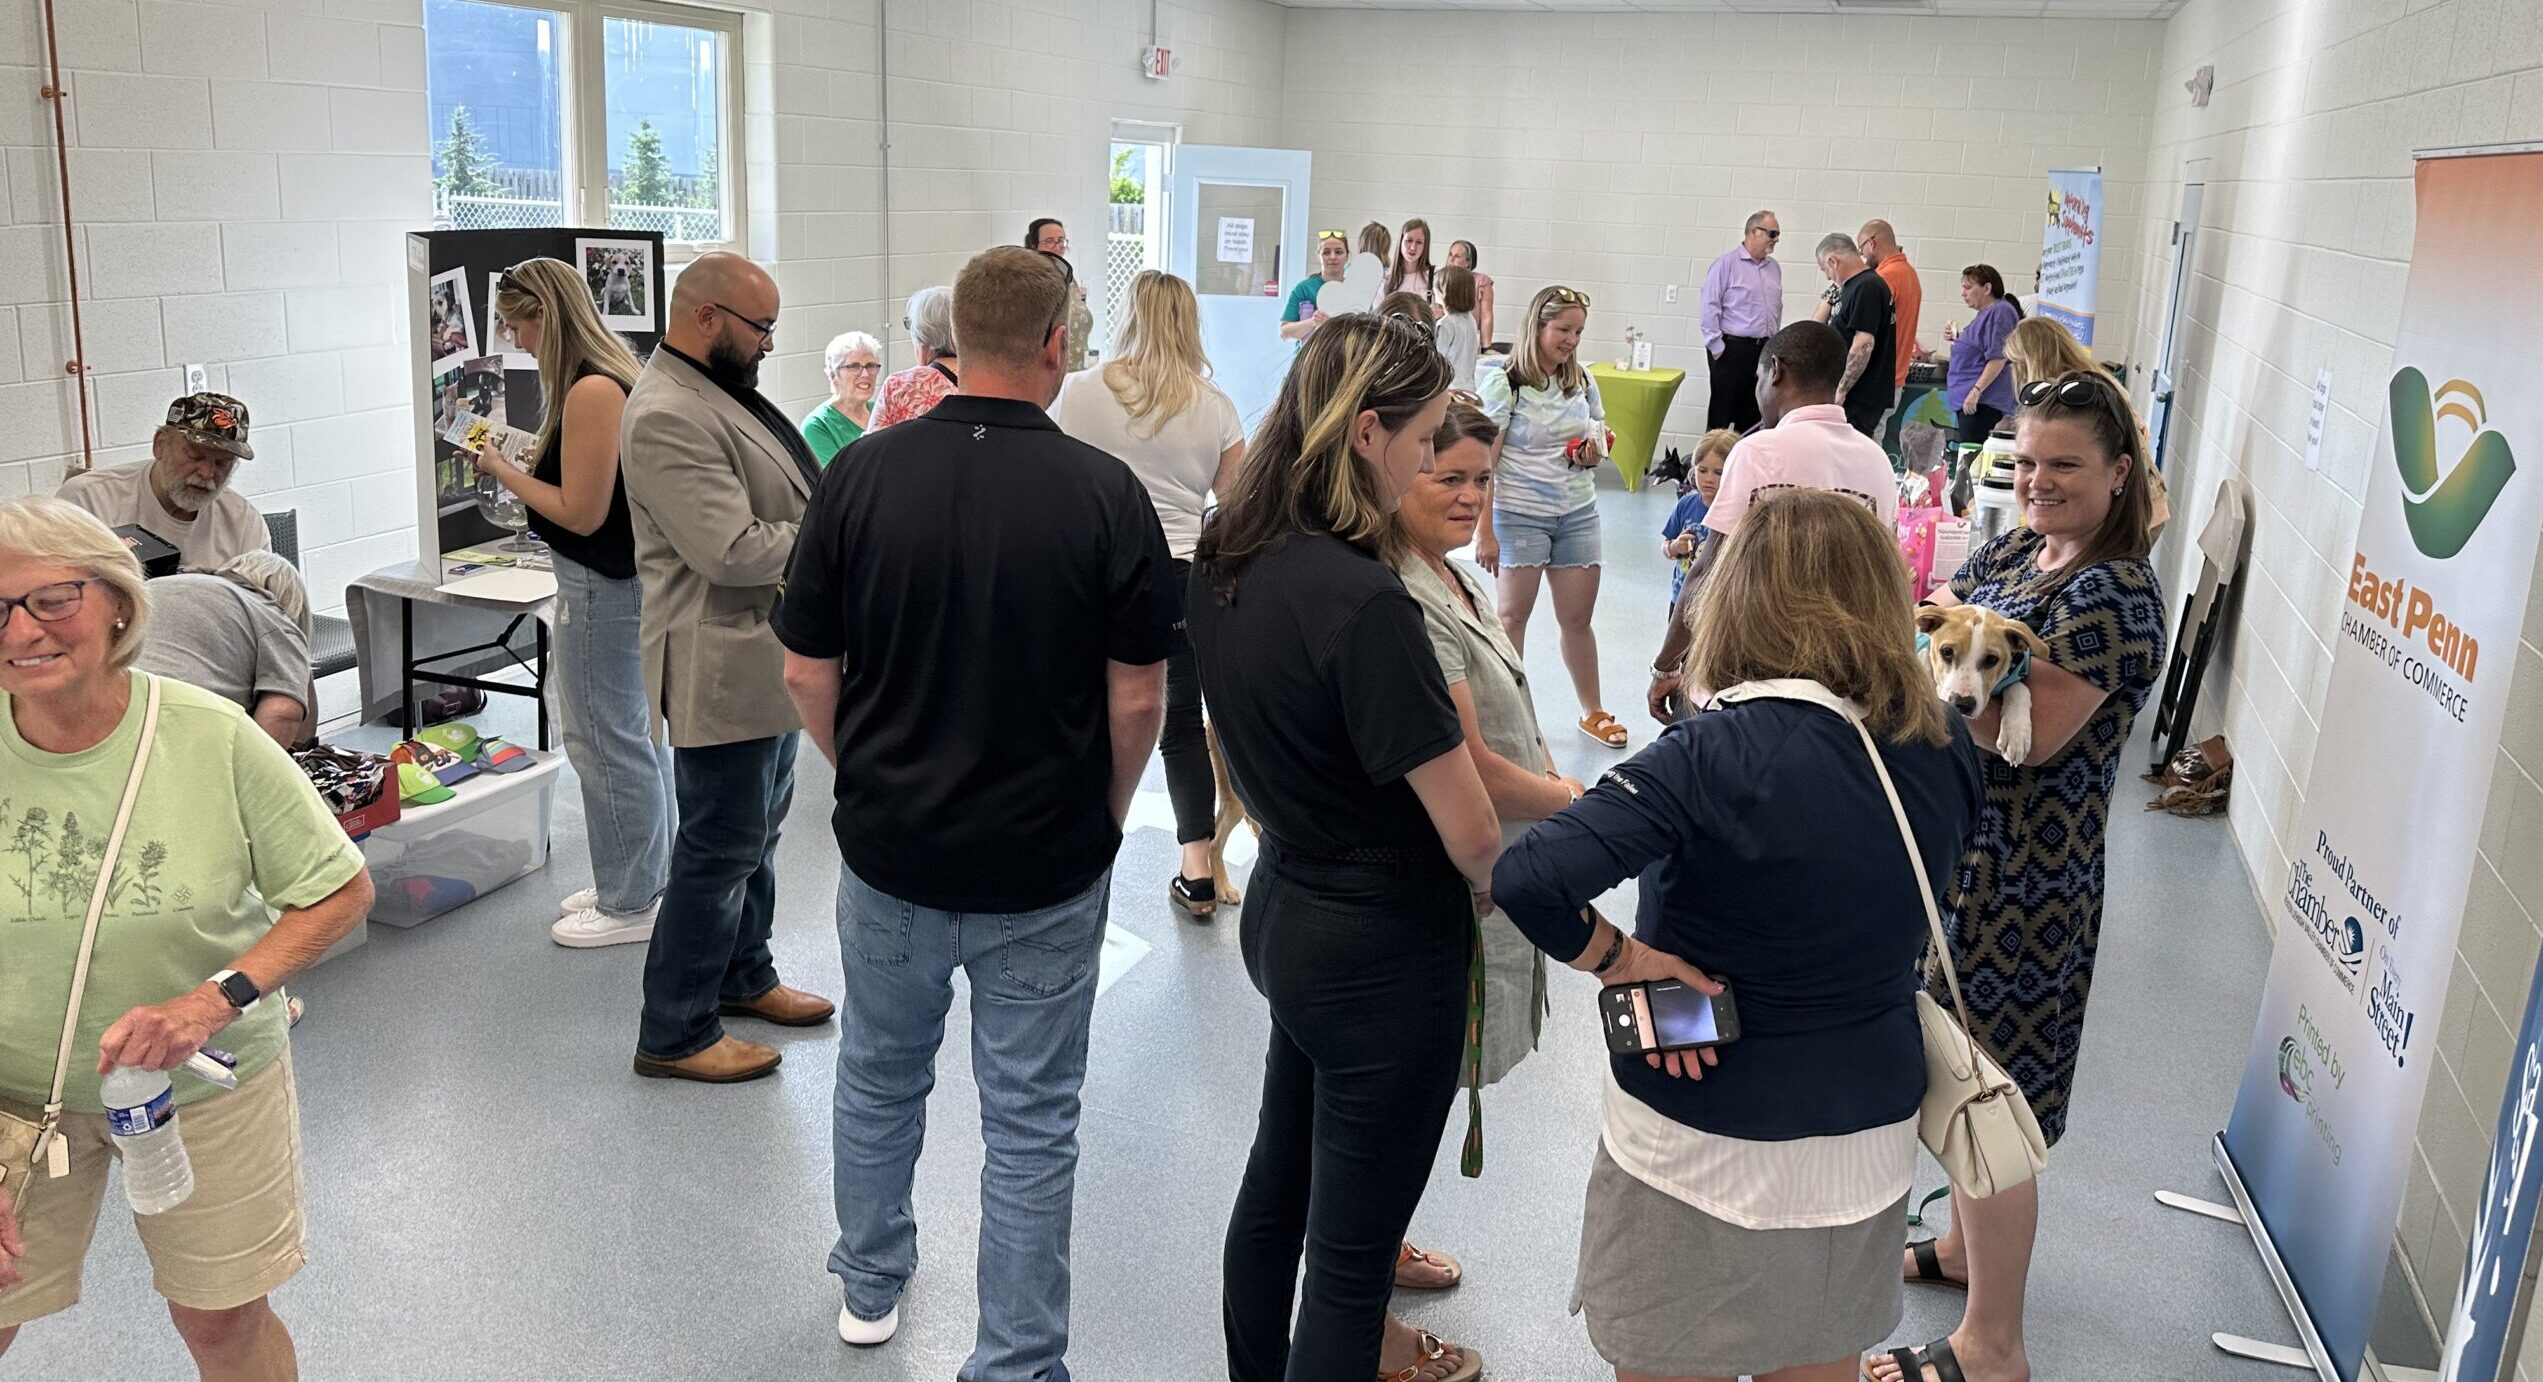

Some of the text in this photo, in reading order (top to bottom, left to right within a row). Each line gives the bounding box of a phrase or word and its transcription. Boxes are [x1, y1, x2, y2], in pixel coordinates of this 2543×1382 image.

[1156, 48, 1171, 77] EXIT
[2348, 552, 2479, 684] East Penn
[2341, 611, 2468, 723] CHAMBER OF COMMERCE
[2288, 861, 2340, 951] Chamber
[2299, 859, 2313, 888] The
[2316, 829, 2402, 941] Proud Partner of
[2379, 969, 2404, 1030] Main
[2293, 1047, 2315, 1091] ebc
[2298, 1003, 2346, 1090] Printed by
[2305, 1101, 2342, 1166] printing
